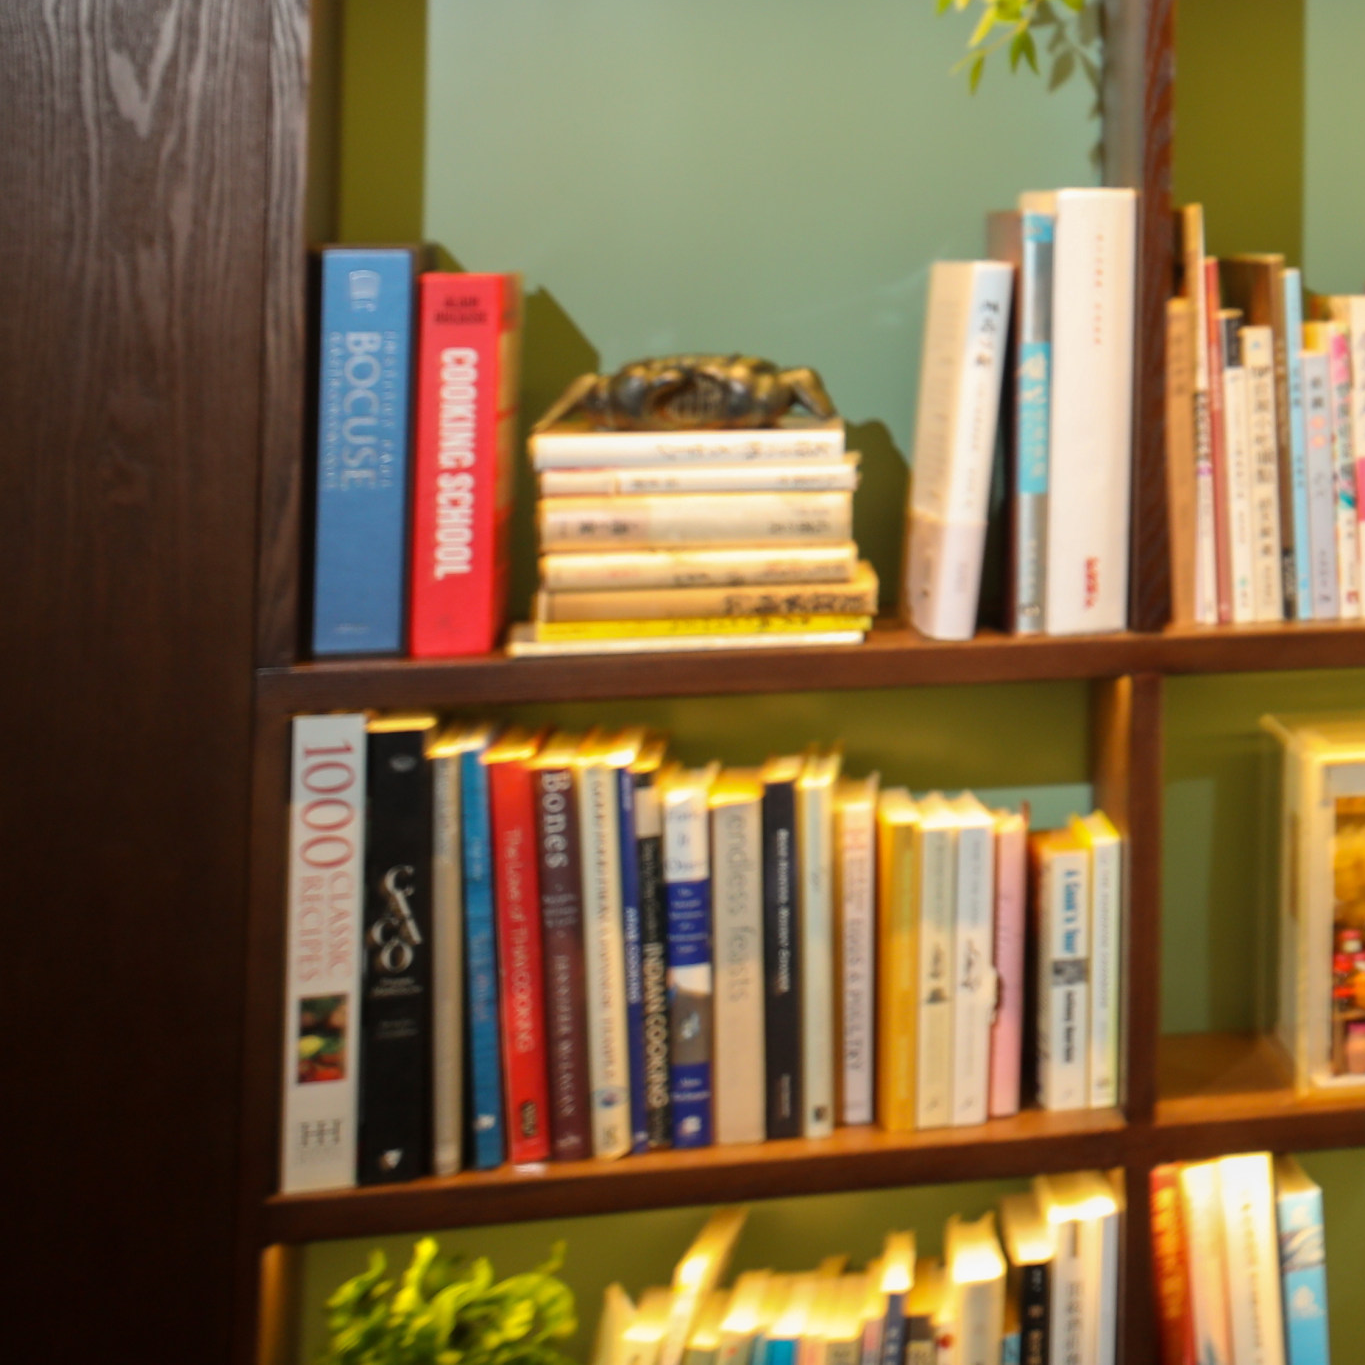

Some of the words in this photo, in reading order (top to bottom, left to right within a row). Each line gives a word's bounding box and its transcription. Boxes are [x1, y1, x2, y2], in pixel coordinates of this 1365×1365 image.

[341, 331, 381, 491] BOCUSE
[438, 347, 479, 469] COOKING
[434, 472, 475, 580] SCHOOL
[300, 740, 356, 870] 1000
[504, 830, 524, 866] The
[541, 771, 572, 870] Bones
[505, 867, 526, 903] Love
[725, 812, 755, 916] endless
[297, 875, 326, 983] RECIPES
[326, 871, 354, 978] CLASSIC
[727, 925, 758, 1003] feasts
[1063, 928, 1079, 954] Tour
[511, 968, 537, 1053] COOKING
[642, 942, 664, 1014] INDIAN
[644, 1016, 669, 1108] COOKING
